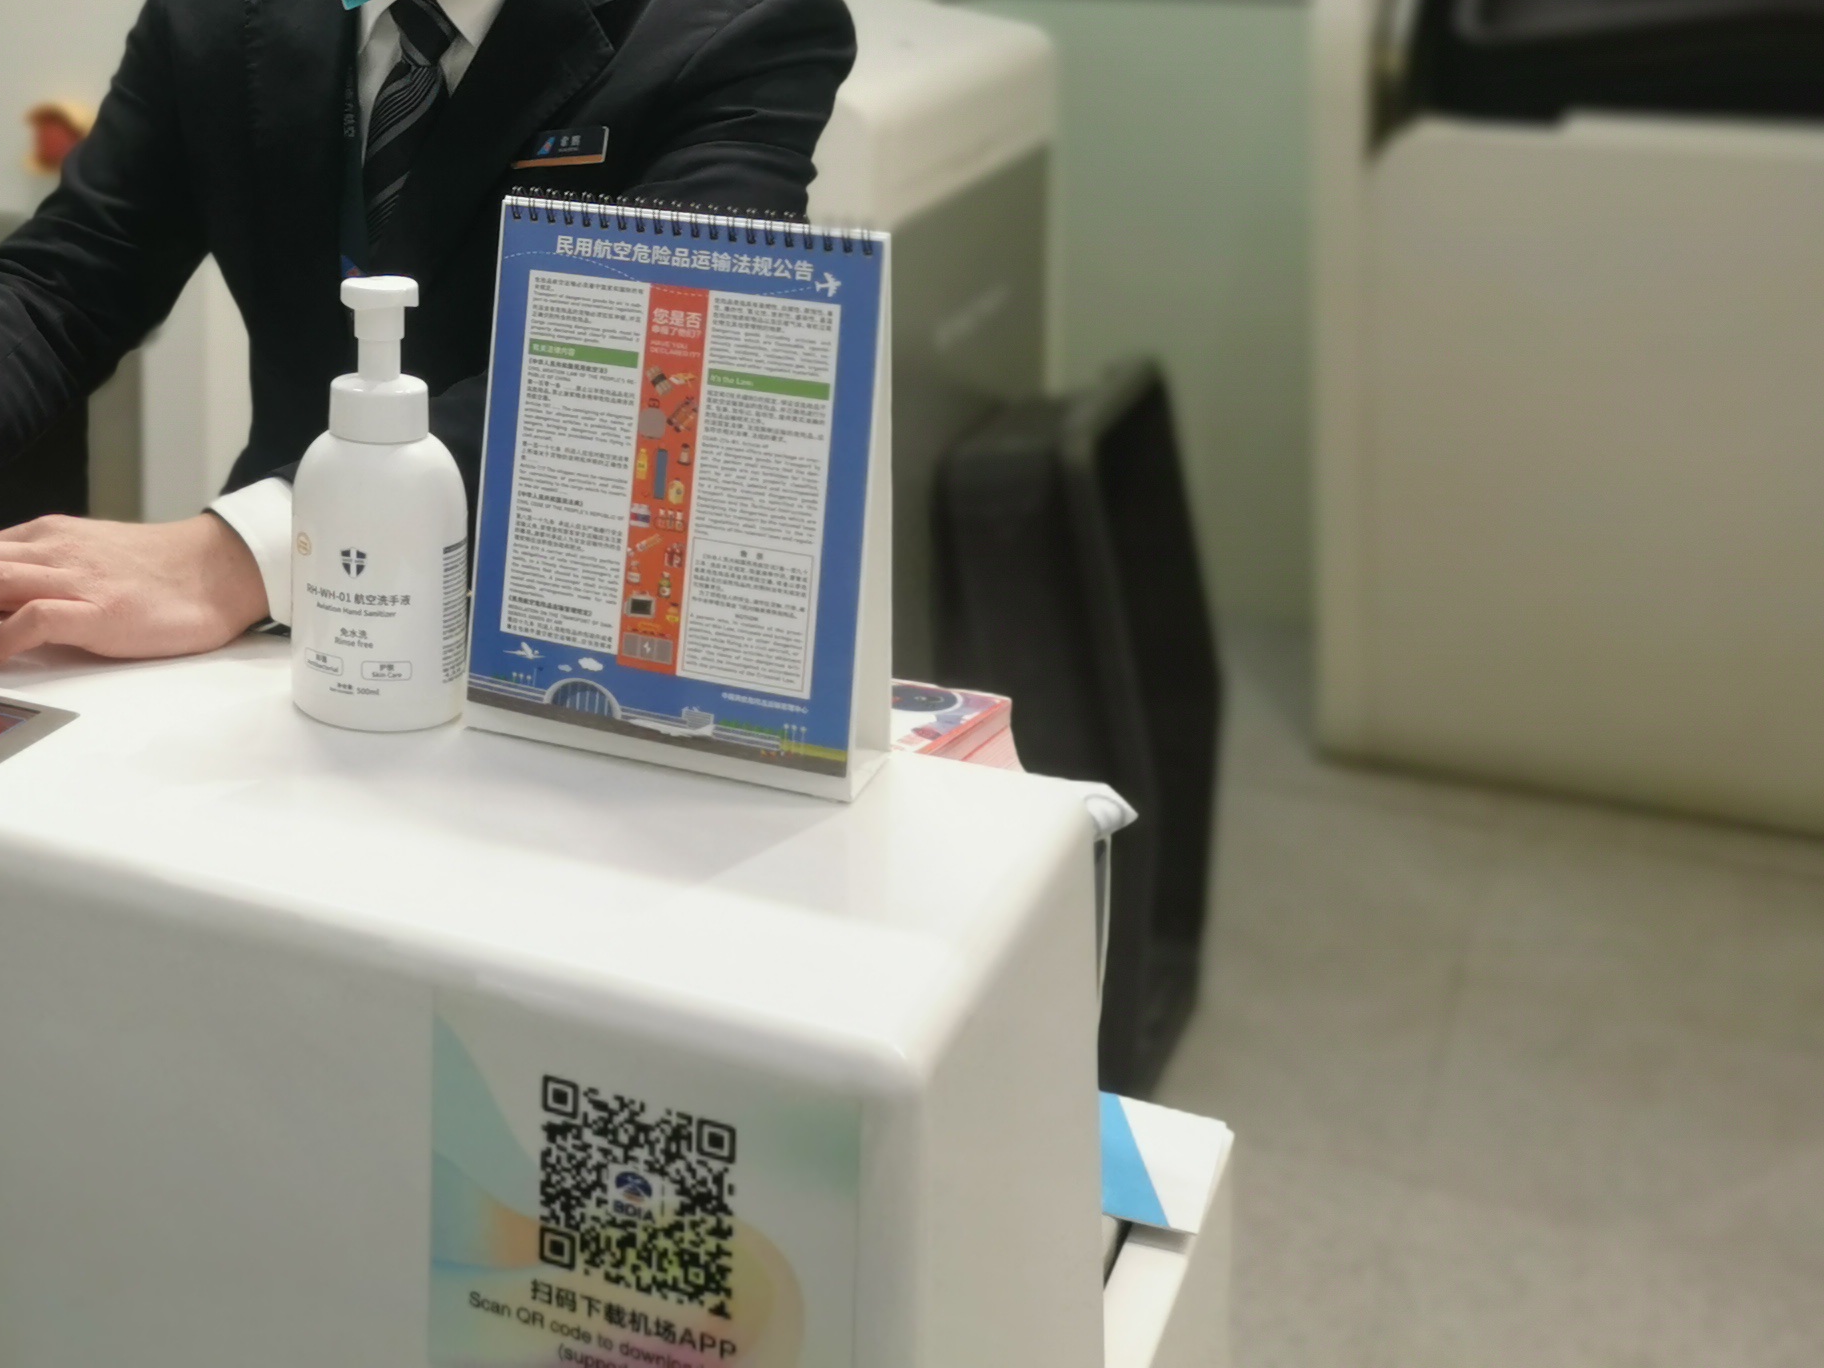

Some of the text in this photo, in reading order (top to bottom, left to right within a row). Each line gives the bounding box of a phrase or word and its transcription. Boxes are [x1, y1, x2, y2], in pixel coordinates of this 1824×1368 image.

[555, 234, 815, 282] 民用航空危险品运输法规公告
[652, 307, 703, 329] 您是否
[354, 593, 411, 607] 航空洗手液
[612, 1198, 656, 1224] BDIA
[468, 1290, 512, 1319] Scan
[516, 1306, 545, 1330] QR
[549, 1318, 593, 1345] code
[597, 1333, 614, 1352] to
[530, 1278, 737, 1359] 扫码下载机场APP
